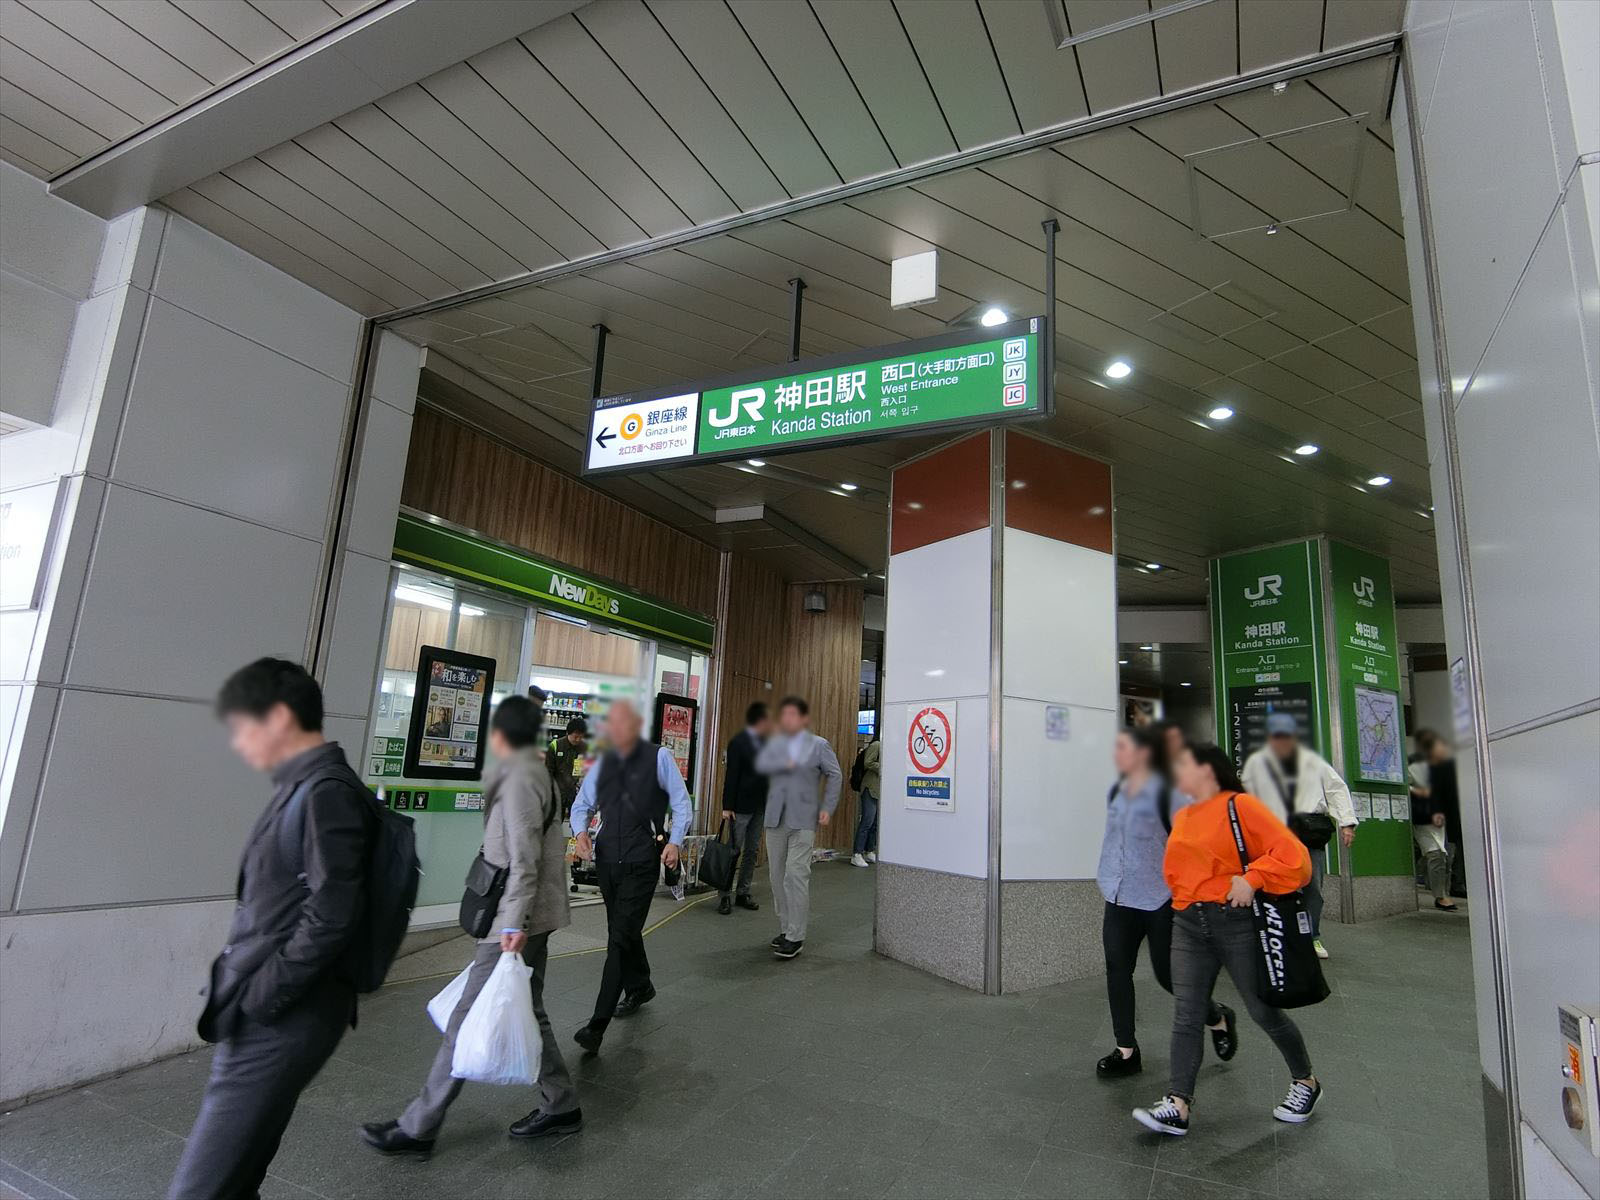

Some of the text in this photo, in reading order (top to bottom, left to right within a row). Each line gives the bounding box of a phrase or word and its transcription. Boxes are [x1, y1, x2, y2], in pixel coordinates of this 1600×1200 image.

[1007, 344, 1021, 356] JK
[1007, 367, 1021, 378] JY
[774, 370, 866, 414] 神田駅
[881, 375, 959, 395] West Entrance
[880, 395, 907, 407] 西入口
[1008, 389, 1022, 400] JC
[708, 387, 766, 428] JR
[646, 405, 688, 426] 銀座線
[771, 408, 872, 436] Kanda Station
[627, 421, 636, 432] G
[645, 424, 688, 437] Ginza Line
[714, 424, 756, 440] JR東日本
[618, 438, 688, 456] 北口方面へお回り下さい
[1244, 574, 1282, 600] JR
[1353, 576, 1375, 601] JR
[548, 573, 620, 616] NewDays
[1244, 620, 1286, 639] 神田駅
[1355, 620, 1379, 641] 神田駅
[1234, 636, 1300, 650] Kanda Station
[1258, 654, 1276, 665] 入口
[1364, 655, 1375, 667] 入口
[441, 668, 477, 684] 和を楽しむ
[1233, 702, 1239, 712] 1
[1233, 716, 1240, 726] 2
[1234, 729, 1241, 740] 3
[1236, 756, 1241, 766] 5
[922, 788, 940, 796] bicycles
